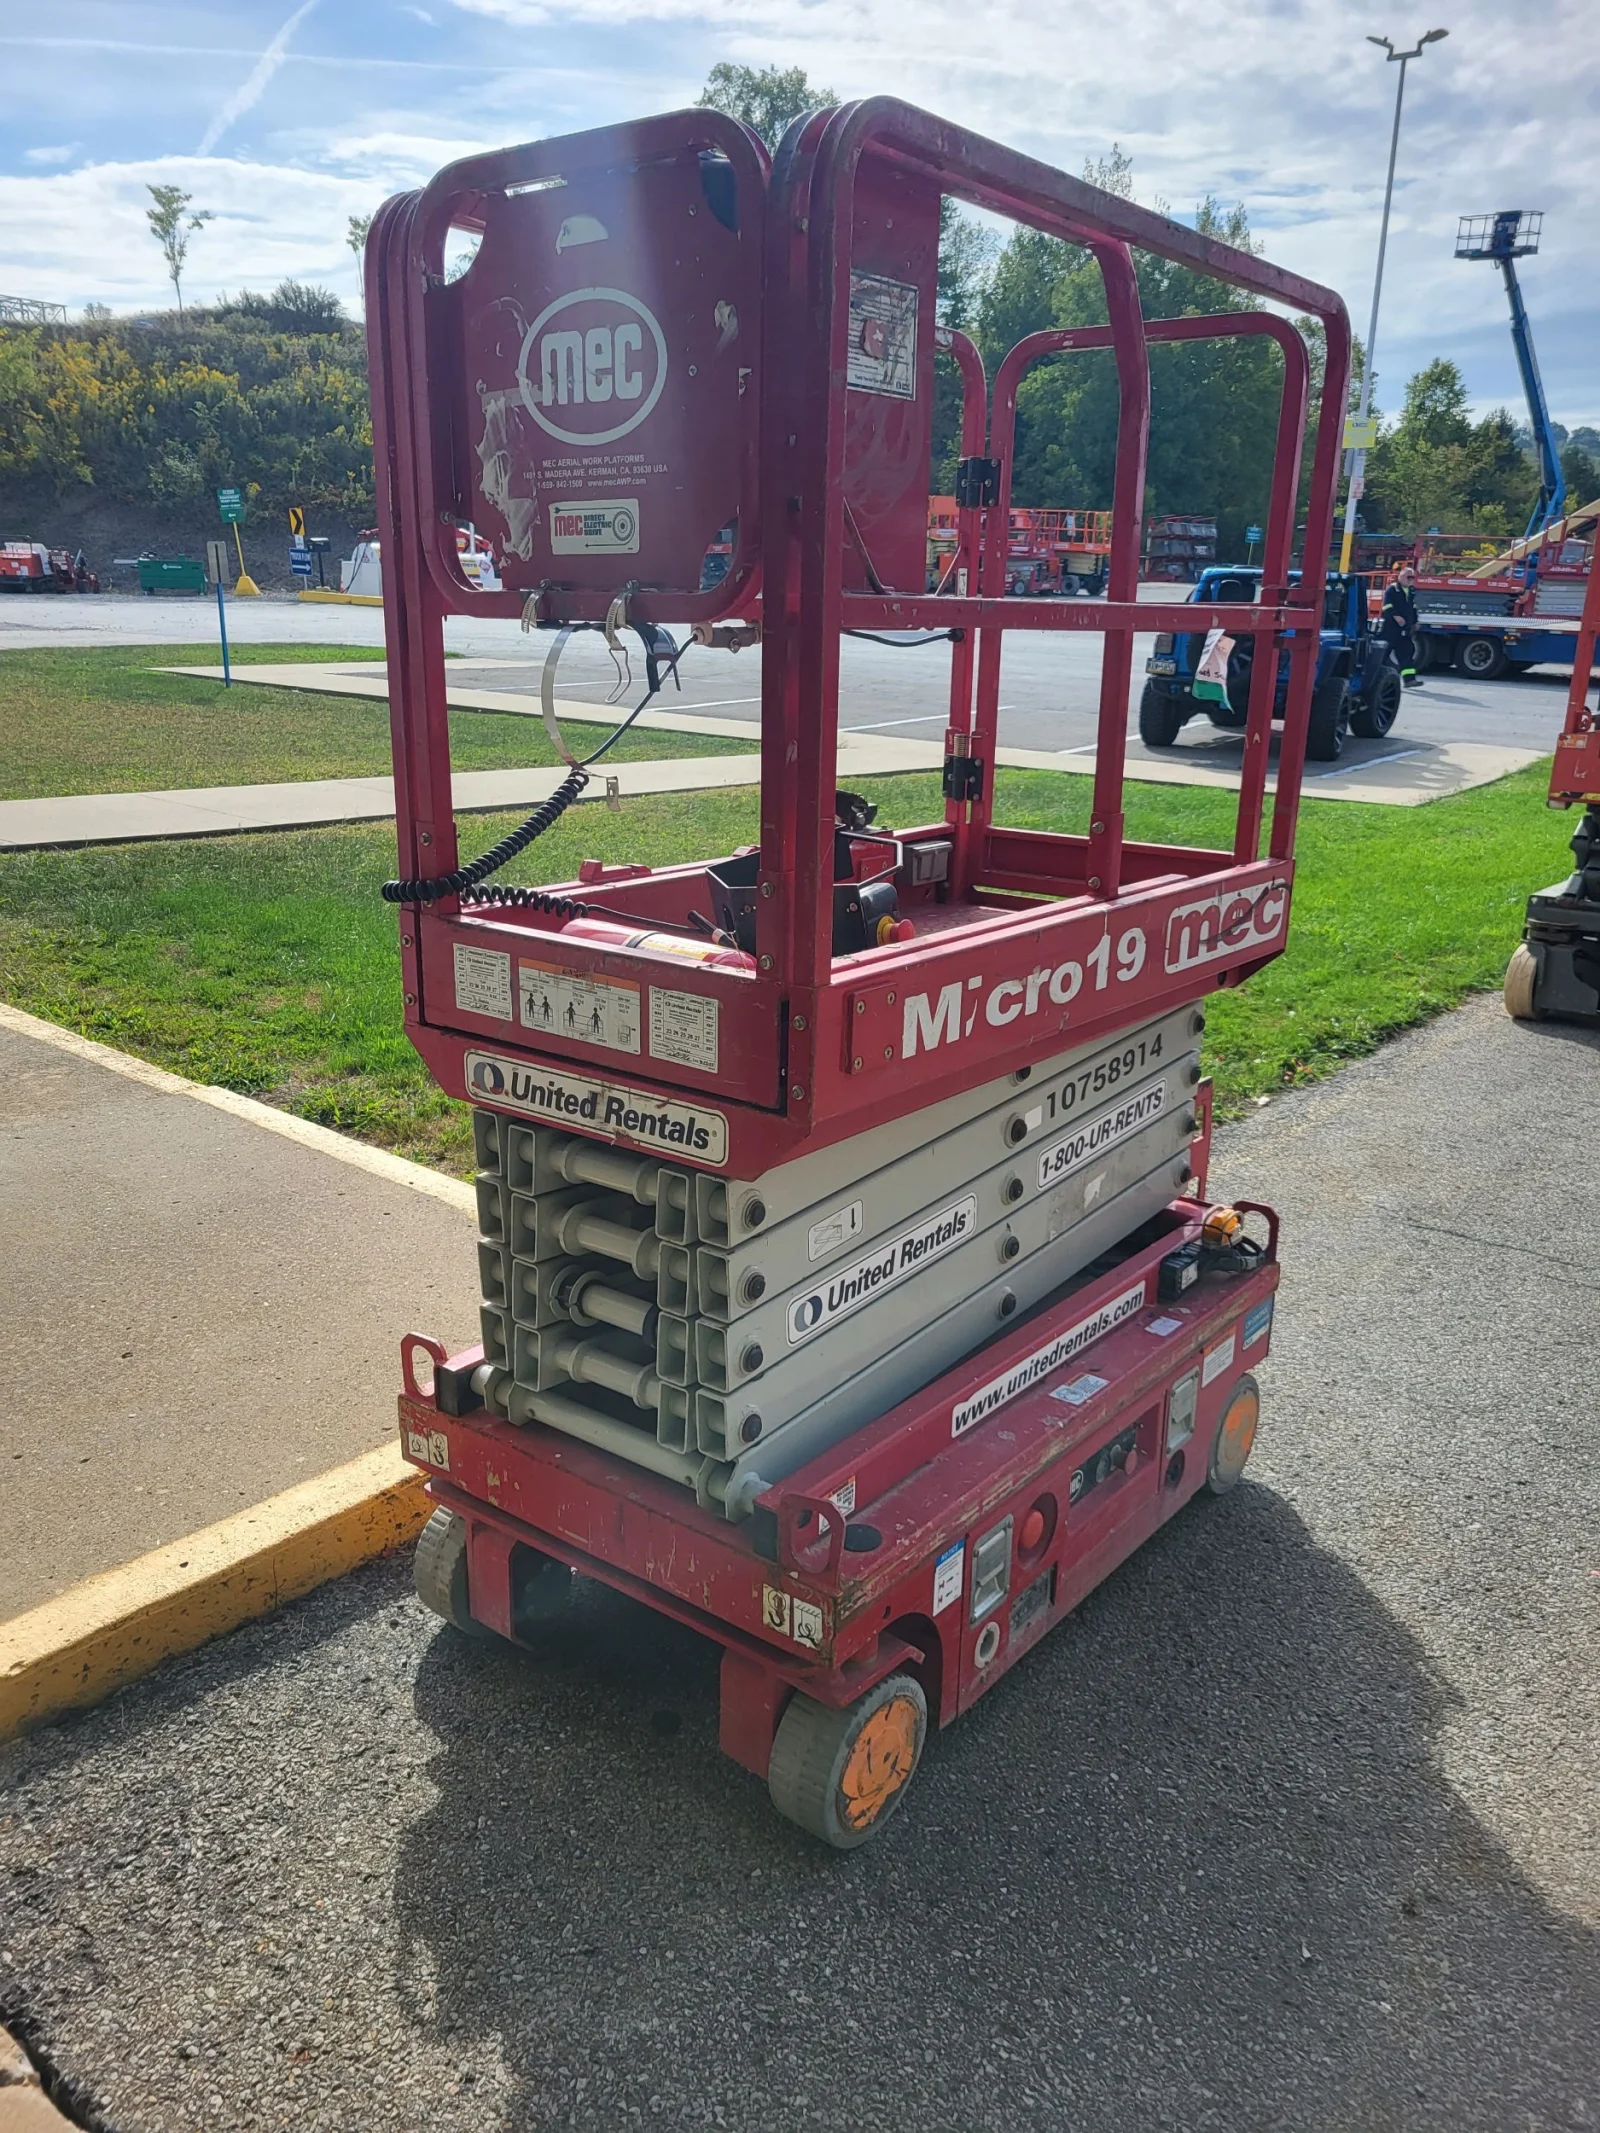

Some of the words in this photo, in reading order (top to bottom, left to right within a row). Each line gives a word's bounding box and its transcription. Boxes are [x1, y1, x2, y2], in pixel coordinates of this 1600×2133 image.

[541, 323, 642, 406] mec
[542, 460, 557, 468] MEC
[557, 458, 581, 467] AERIAL
[582, 456, 602, 466] WORK
[603, 454, 645, 464] PLATFORMS
[545, 468, 572, 478] MADERA
[653, 464, 668, 473] USA
[554, 515, 583, 537] mec
[583, 514, 606, 522] DIRECT
[583, 521, 613, 529] ELECTRIC
[583, 528, 603, 536] DRIVE
[1046, 1033, 1163, 1118] 10758914
[511, 1071, 599, 1120] United
[604, 1095, 710, 1150] Rentals
[1042, 1087, 1163, 1179] 1-800-UR-RENTS
[828, 1248, 896, 1312] United
[900, 1211, 967, 1268] Rentals
[955, 1290, 1143, 1431] www.unitedrentals.com
